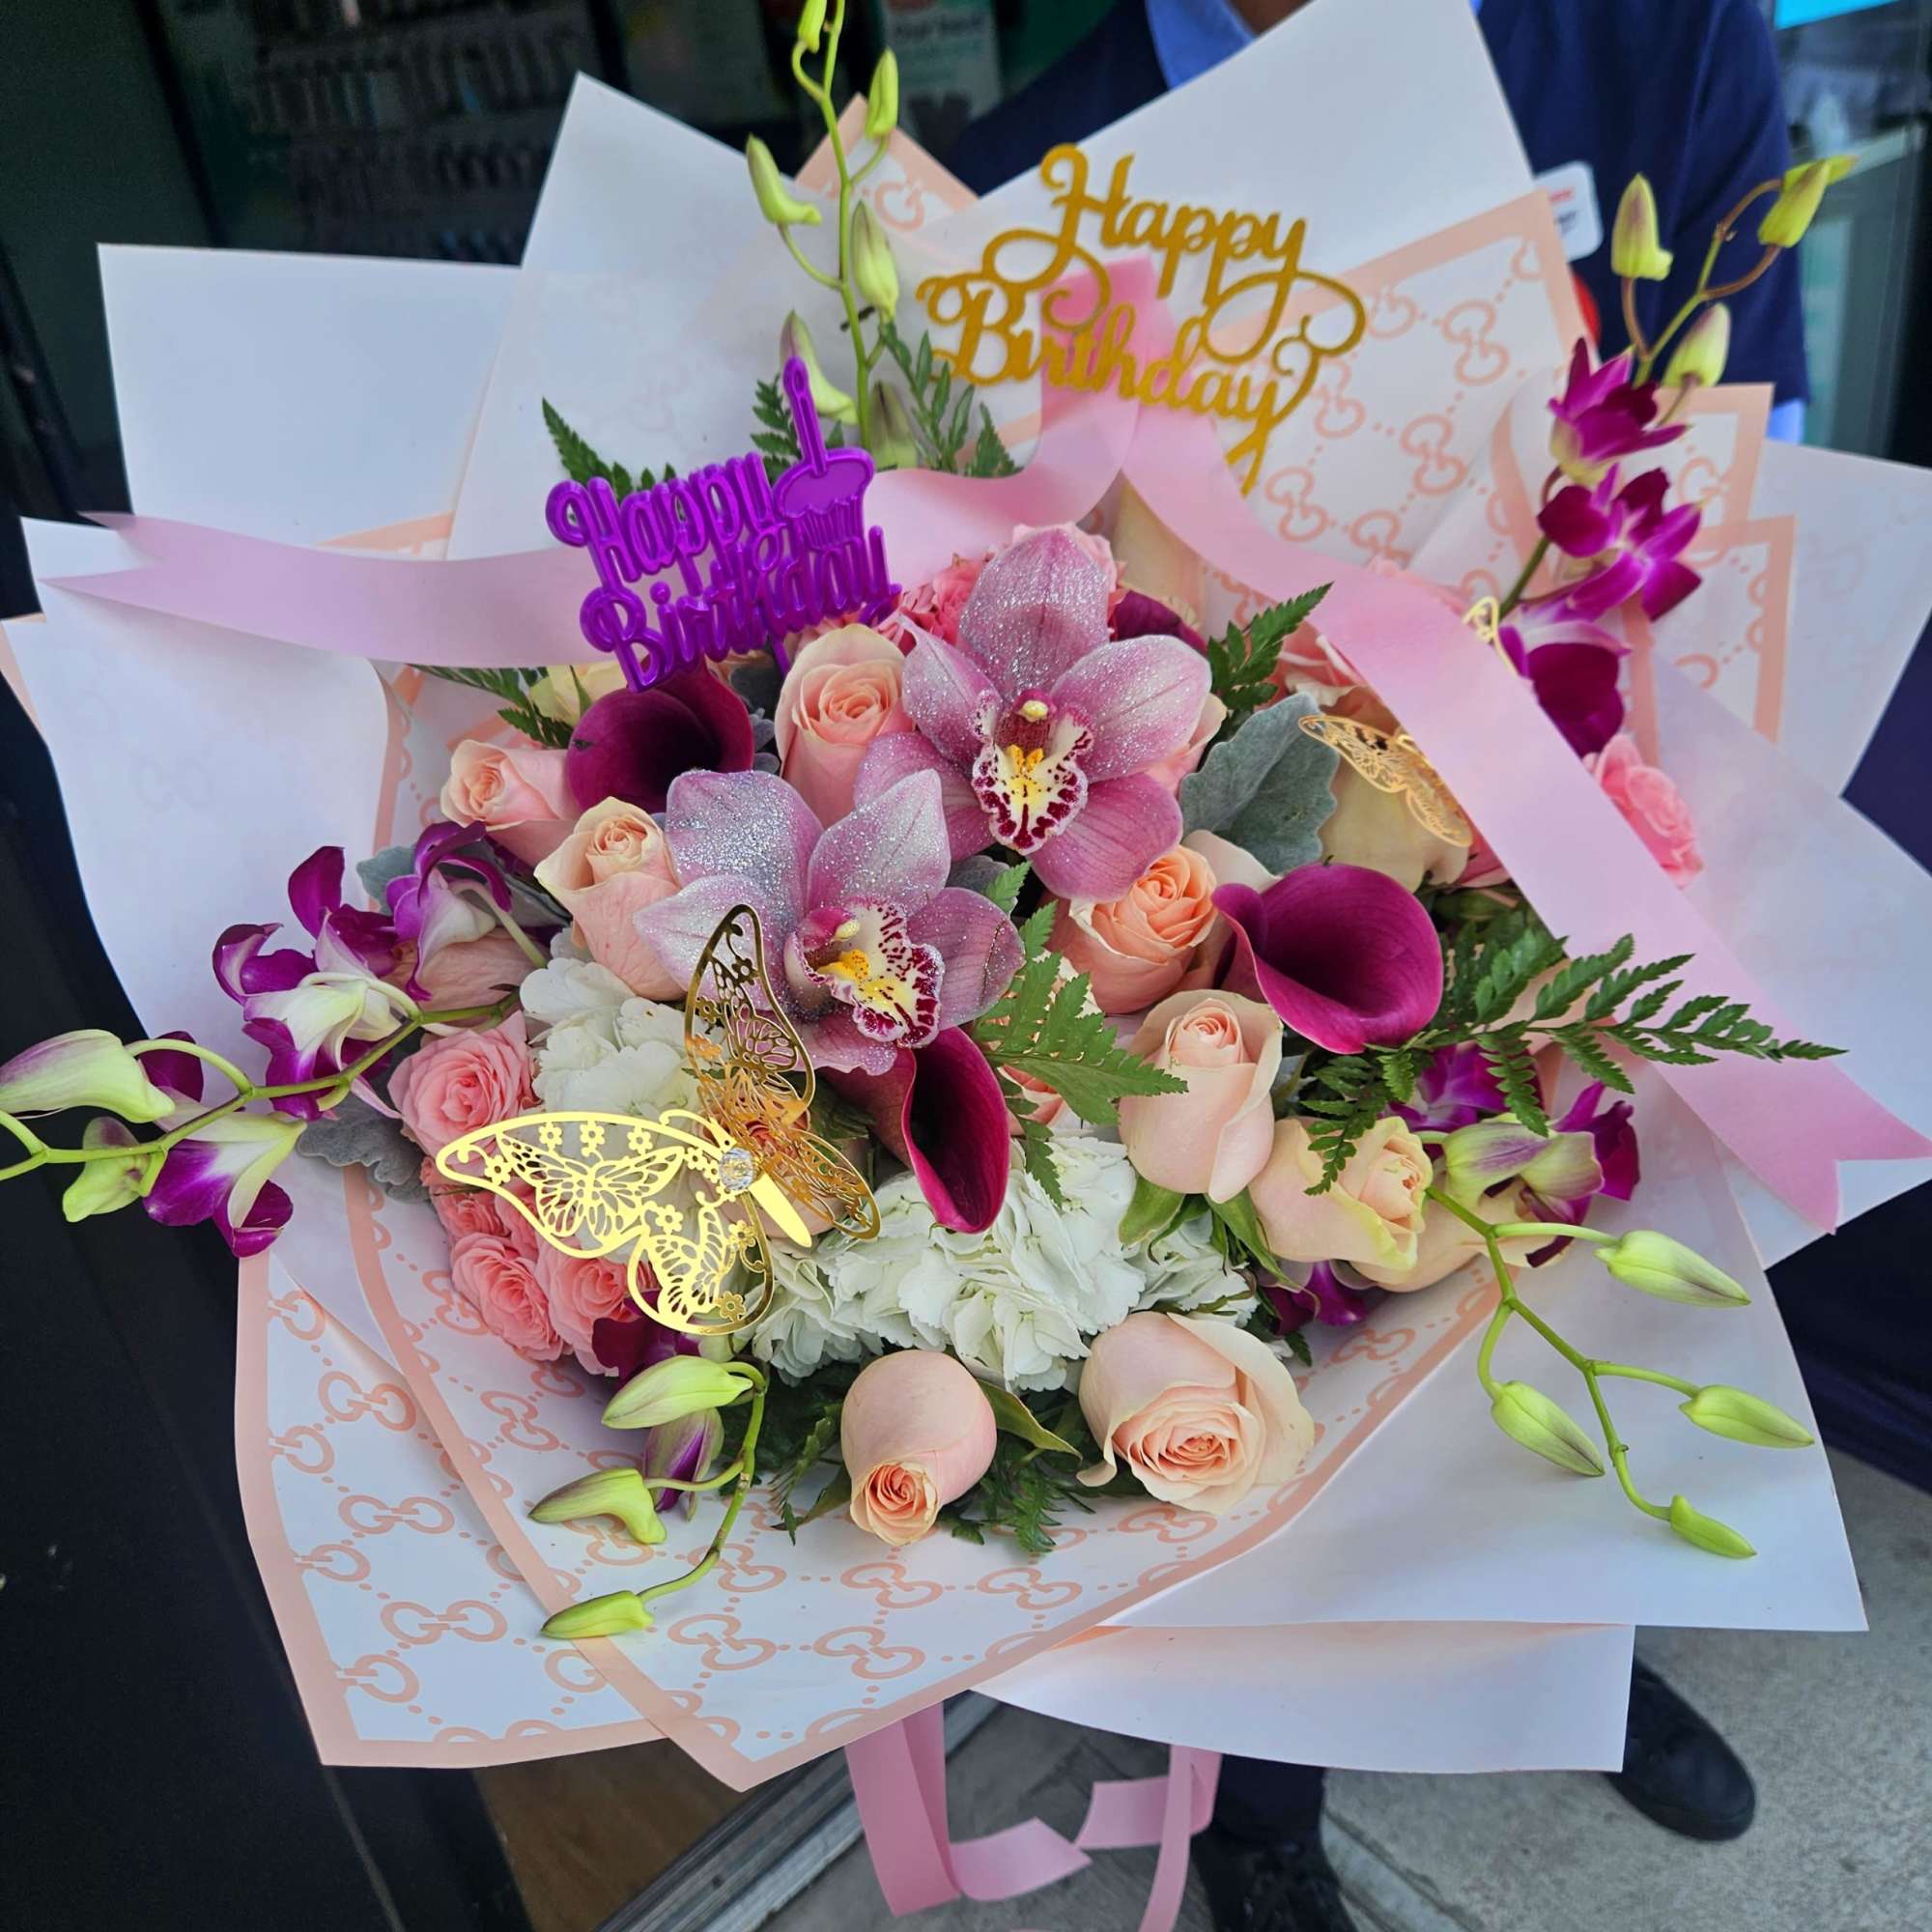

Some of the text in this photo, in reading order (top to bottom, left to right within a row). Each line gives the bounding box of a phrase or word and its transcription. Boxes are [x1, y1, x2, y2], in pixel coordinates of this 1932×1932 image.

[982, 143, 1366, 363] Happy
[915, 272, 1320, 497] Birthday
[546, 451, 778, 596] Happy
[581, 526, 902, 693] Birthday
